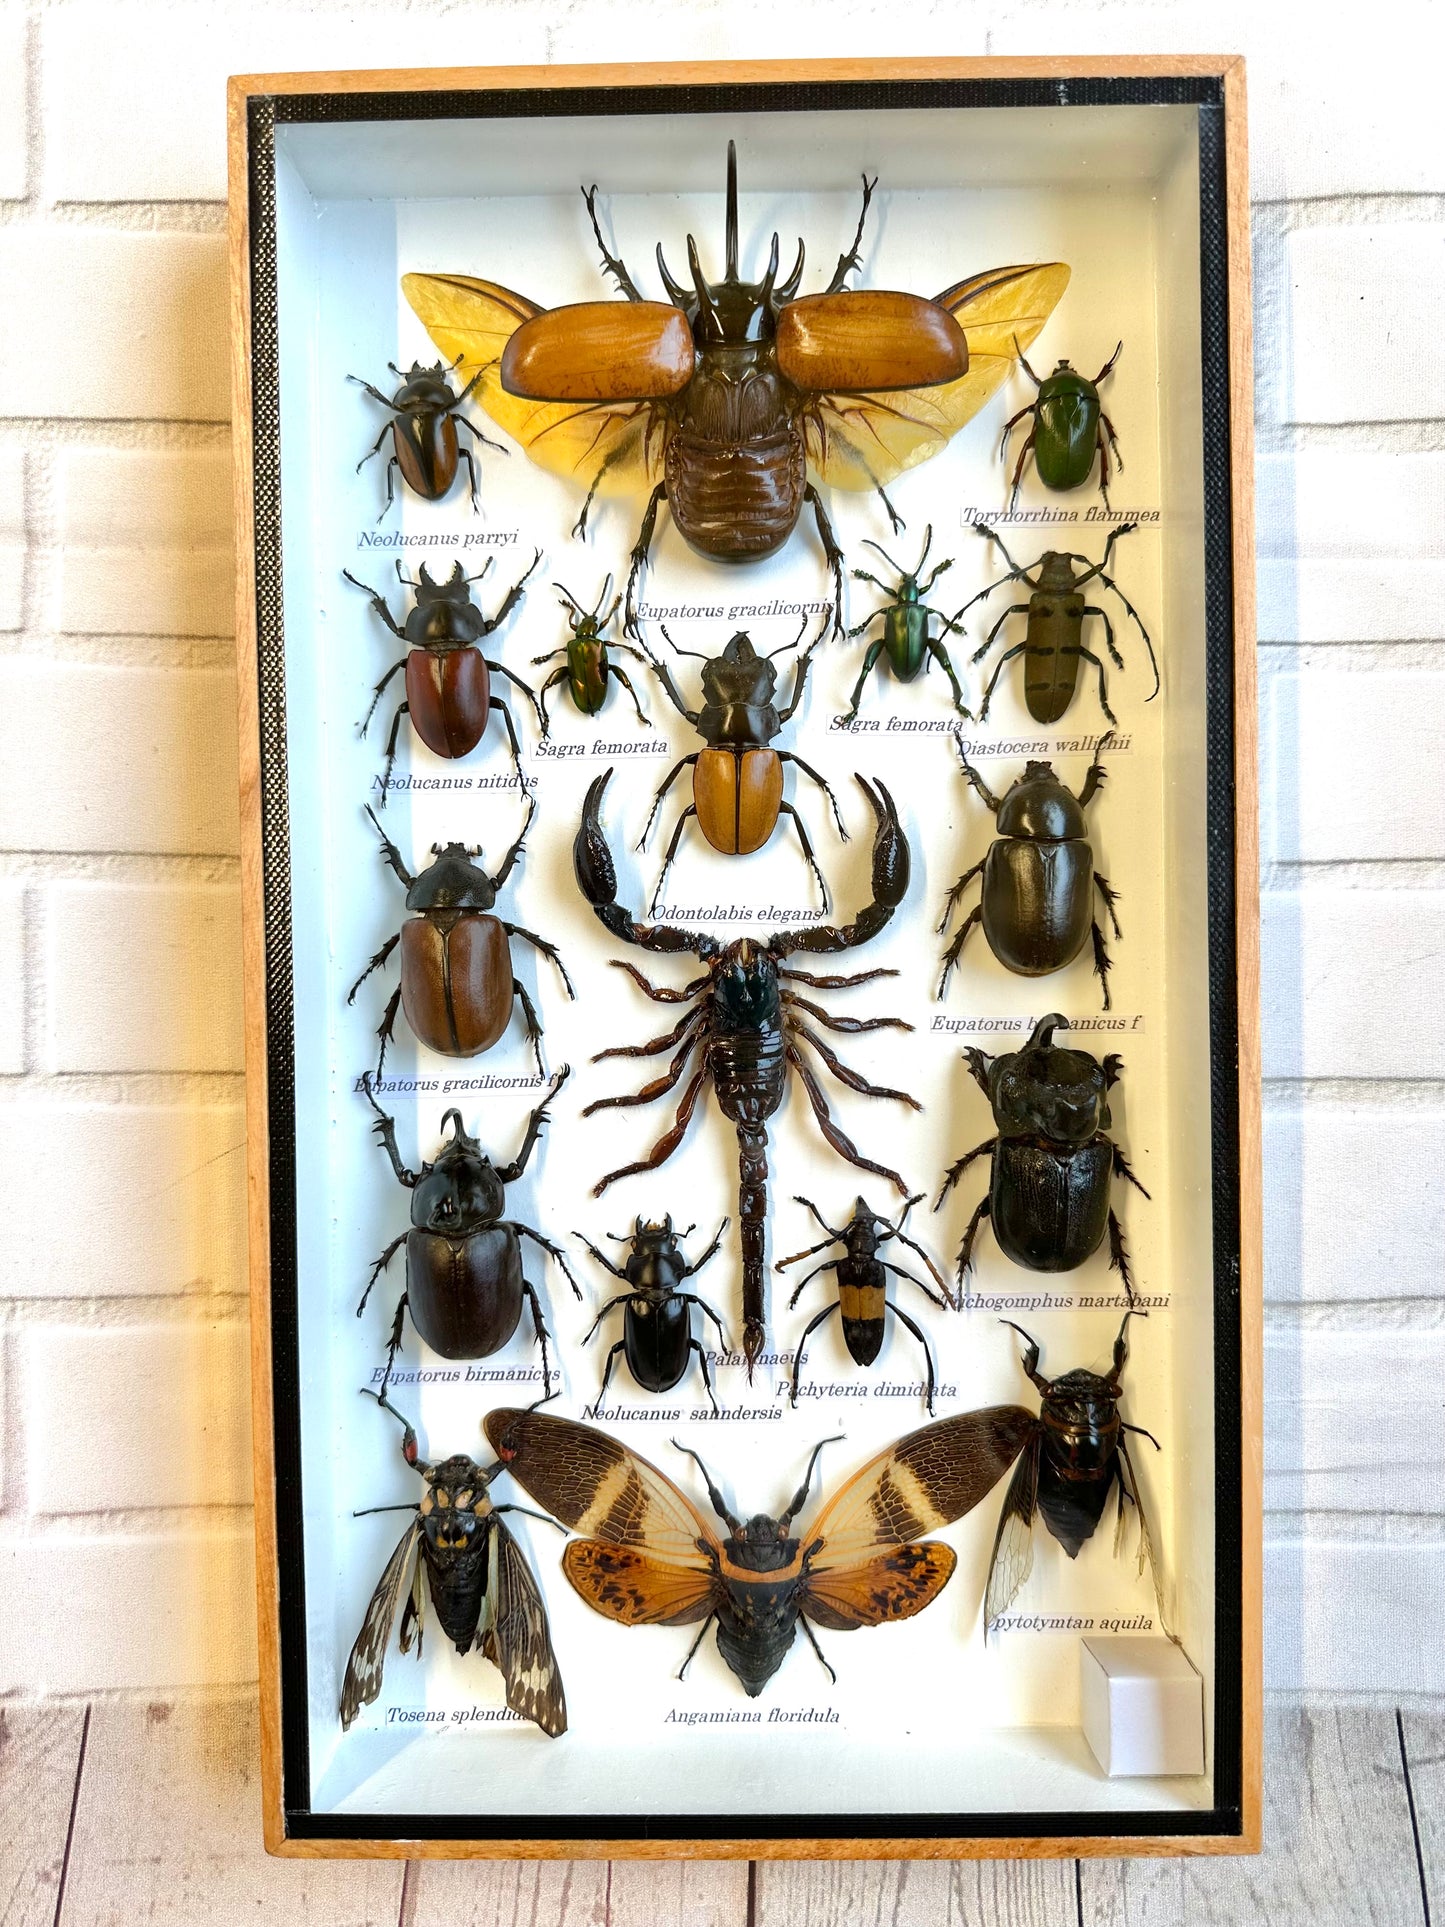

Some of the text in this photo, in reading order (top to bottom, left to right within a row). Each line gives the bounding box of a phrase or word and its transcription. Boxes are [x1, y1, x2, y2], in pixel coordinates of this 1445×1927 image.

[963, 506, 1160, 525] Torynorrhina flammea
[358, 529, 519, 549] Neolucanus parryi
[637, 598, 835, 620] Eupatorus gracilicornis
[829, 715, 963, 734] Sagra femorata
[535, 739, 668, 758] Sagra femorata
[957, 740, 1049, 756] Diastocera
[371, 773, 538, 790] Neolucanus nitidus
[654, 904, 822, 923] Odontolabis elegans
[931, 1015, 1142, 1034] Eupatorus banicus f
[442, 1075, 543, 1093] gracilicornis
[1077, 1293, 1171, 1308] martabani
[371, 1366, 560, 1386] Eupatorus birmanicus
[580, 1405, 680, 1420] Neolucanus
[1099, 1613, 1153, 1632] aquila
[387, 1707, 445, 1722] Tosena
[664, 1707, 840, 1726] Angamiana floridula
